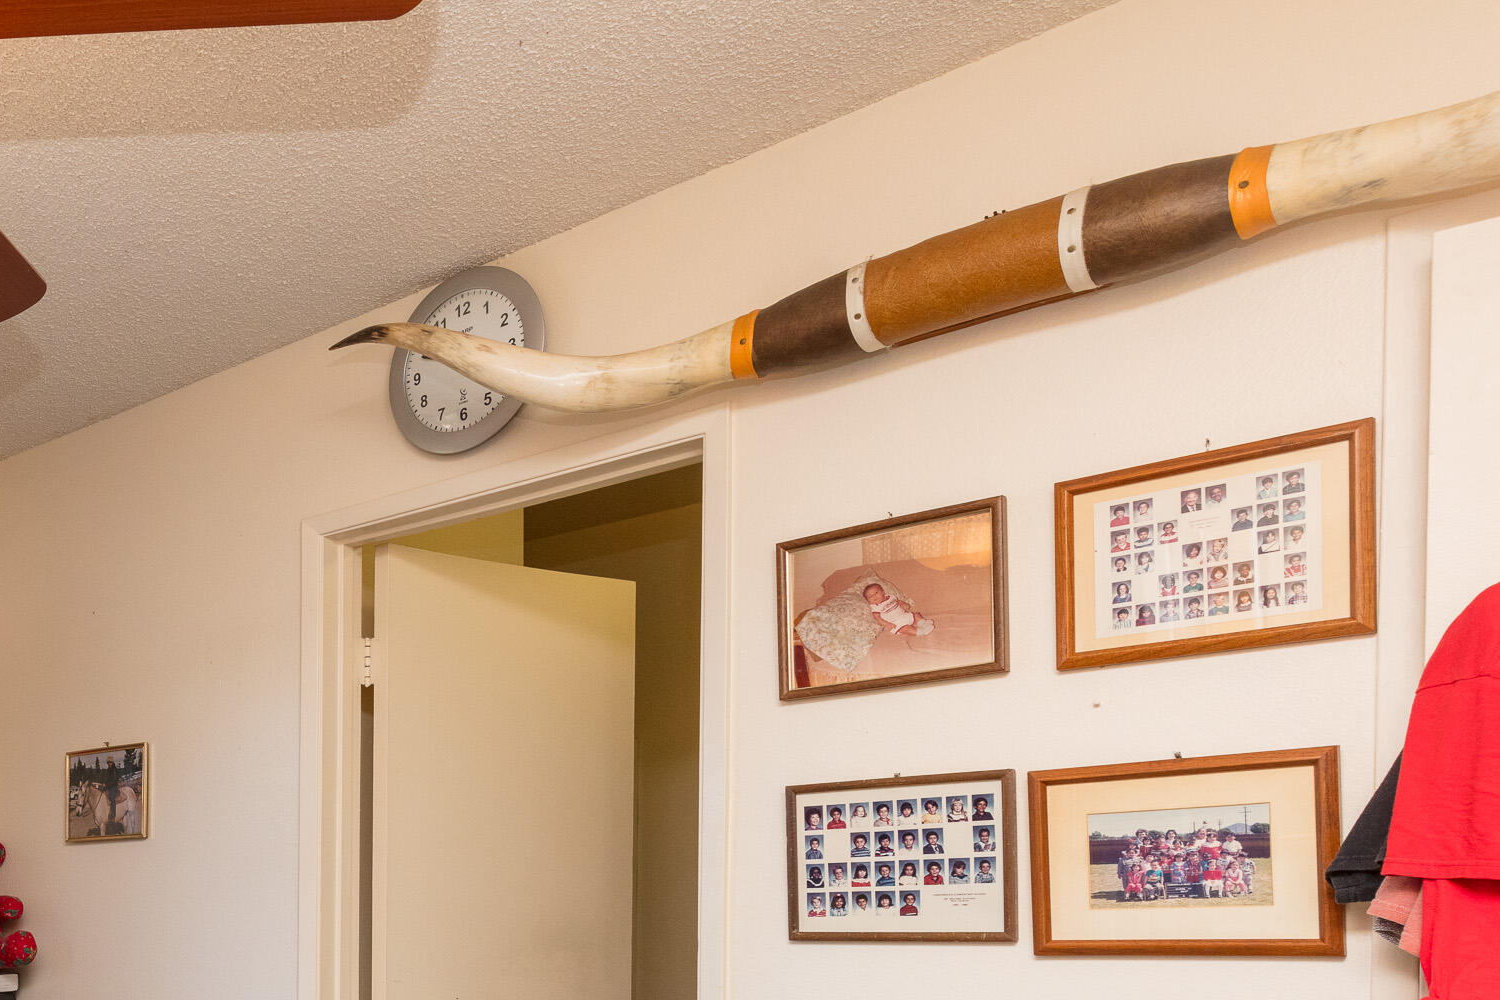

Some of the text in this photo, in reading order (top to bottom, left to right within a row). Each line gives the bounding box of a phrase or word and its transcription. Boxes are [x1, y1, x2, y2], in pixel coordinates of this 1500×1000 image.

[455, 301, 471, 317] 12
[483, 301, 489, 314] 1
[500, 312, 509, 327] 2
[413, 372, 421, 386] 9
[421, 394, 428, 408] 8
[484, 392, 492, 405] 5
[437, 407, 446, 421] 7
[460, 407, 468, 421] 6
